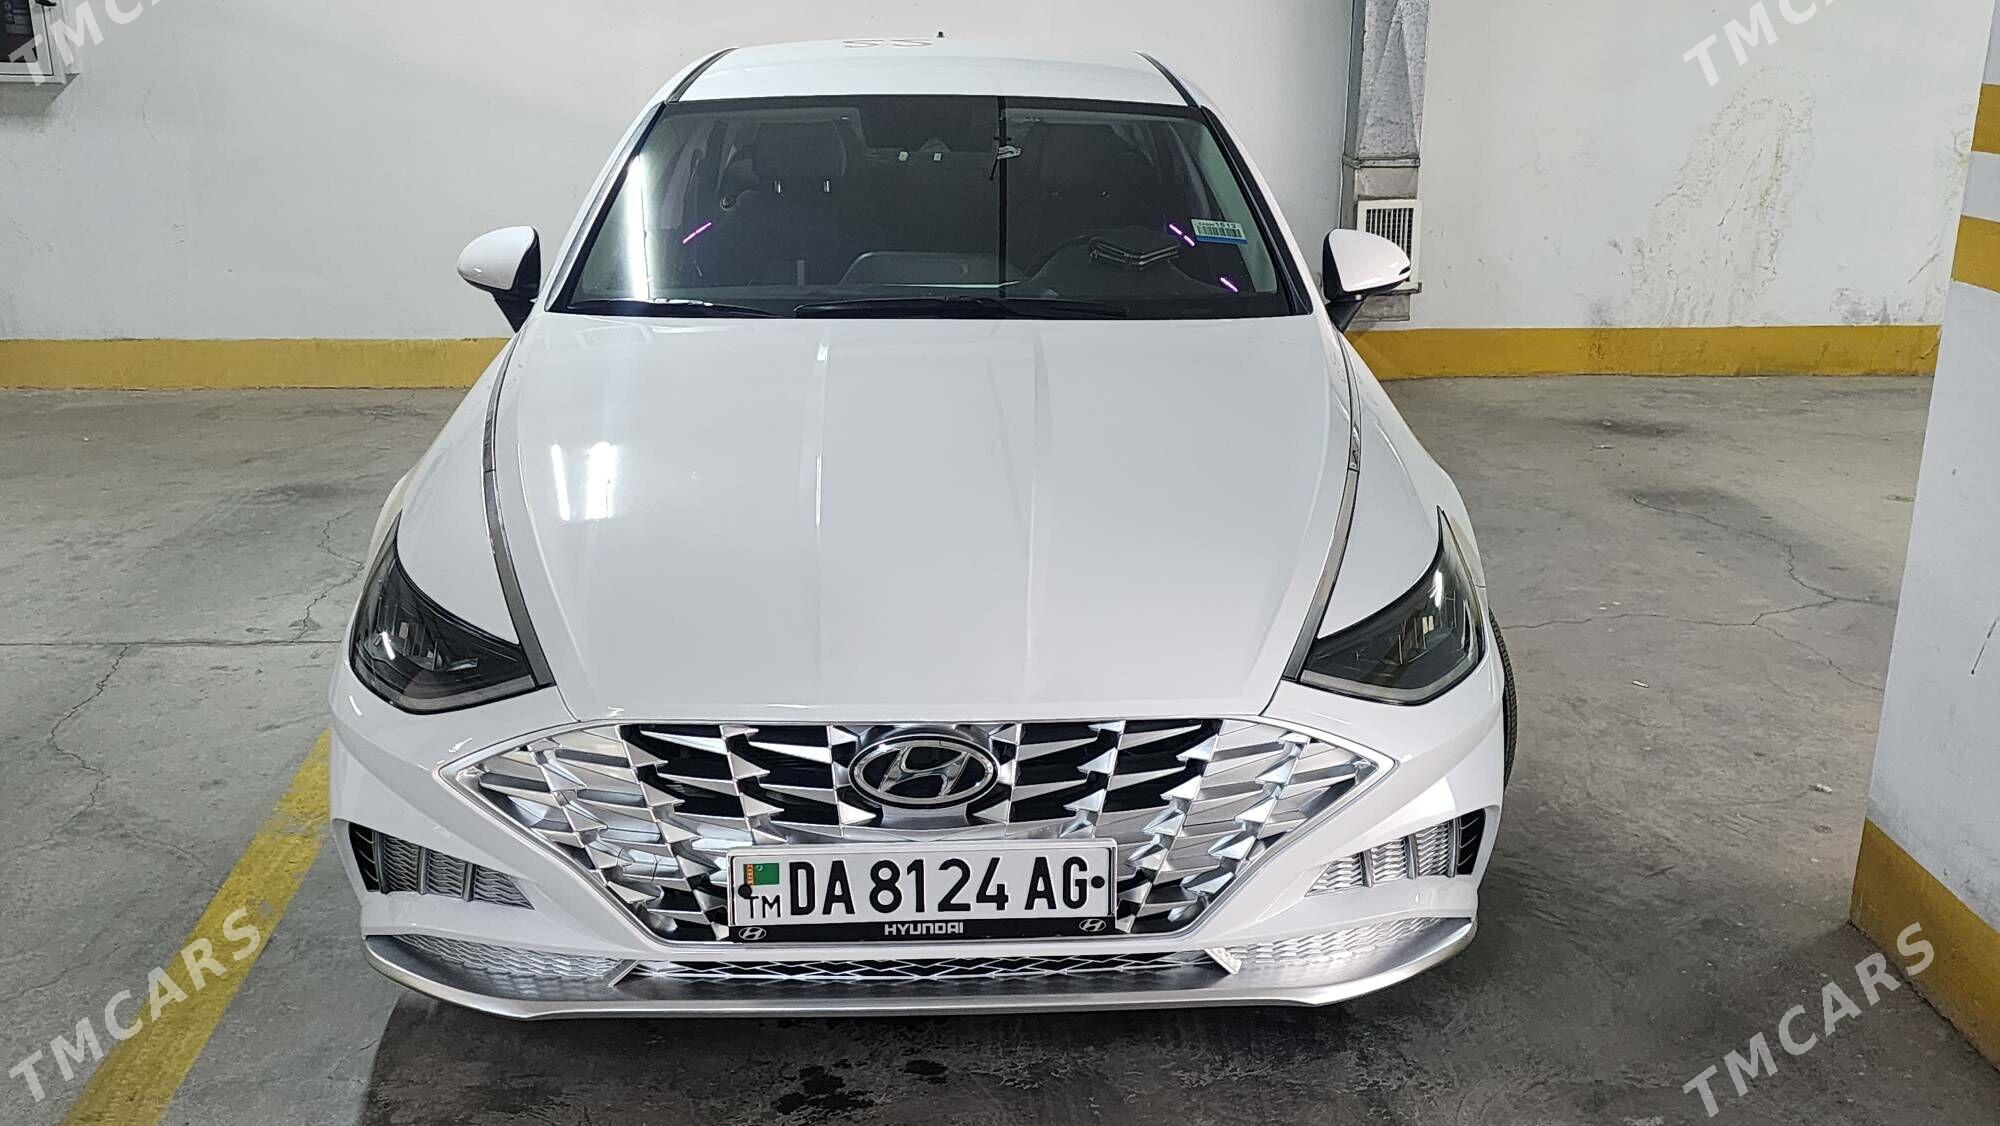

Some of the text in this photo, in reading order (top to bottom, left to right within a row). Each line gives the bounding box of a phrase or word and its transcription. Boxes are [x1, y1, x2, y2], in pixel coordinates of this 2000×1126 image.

[746, 856, 1088, 919] TM DA 8124 AG
[884, 922, 964, 936] HYUNDAI
